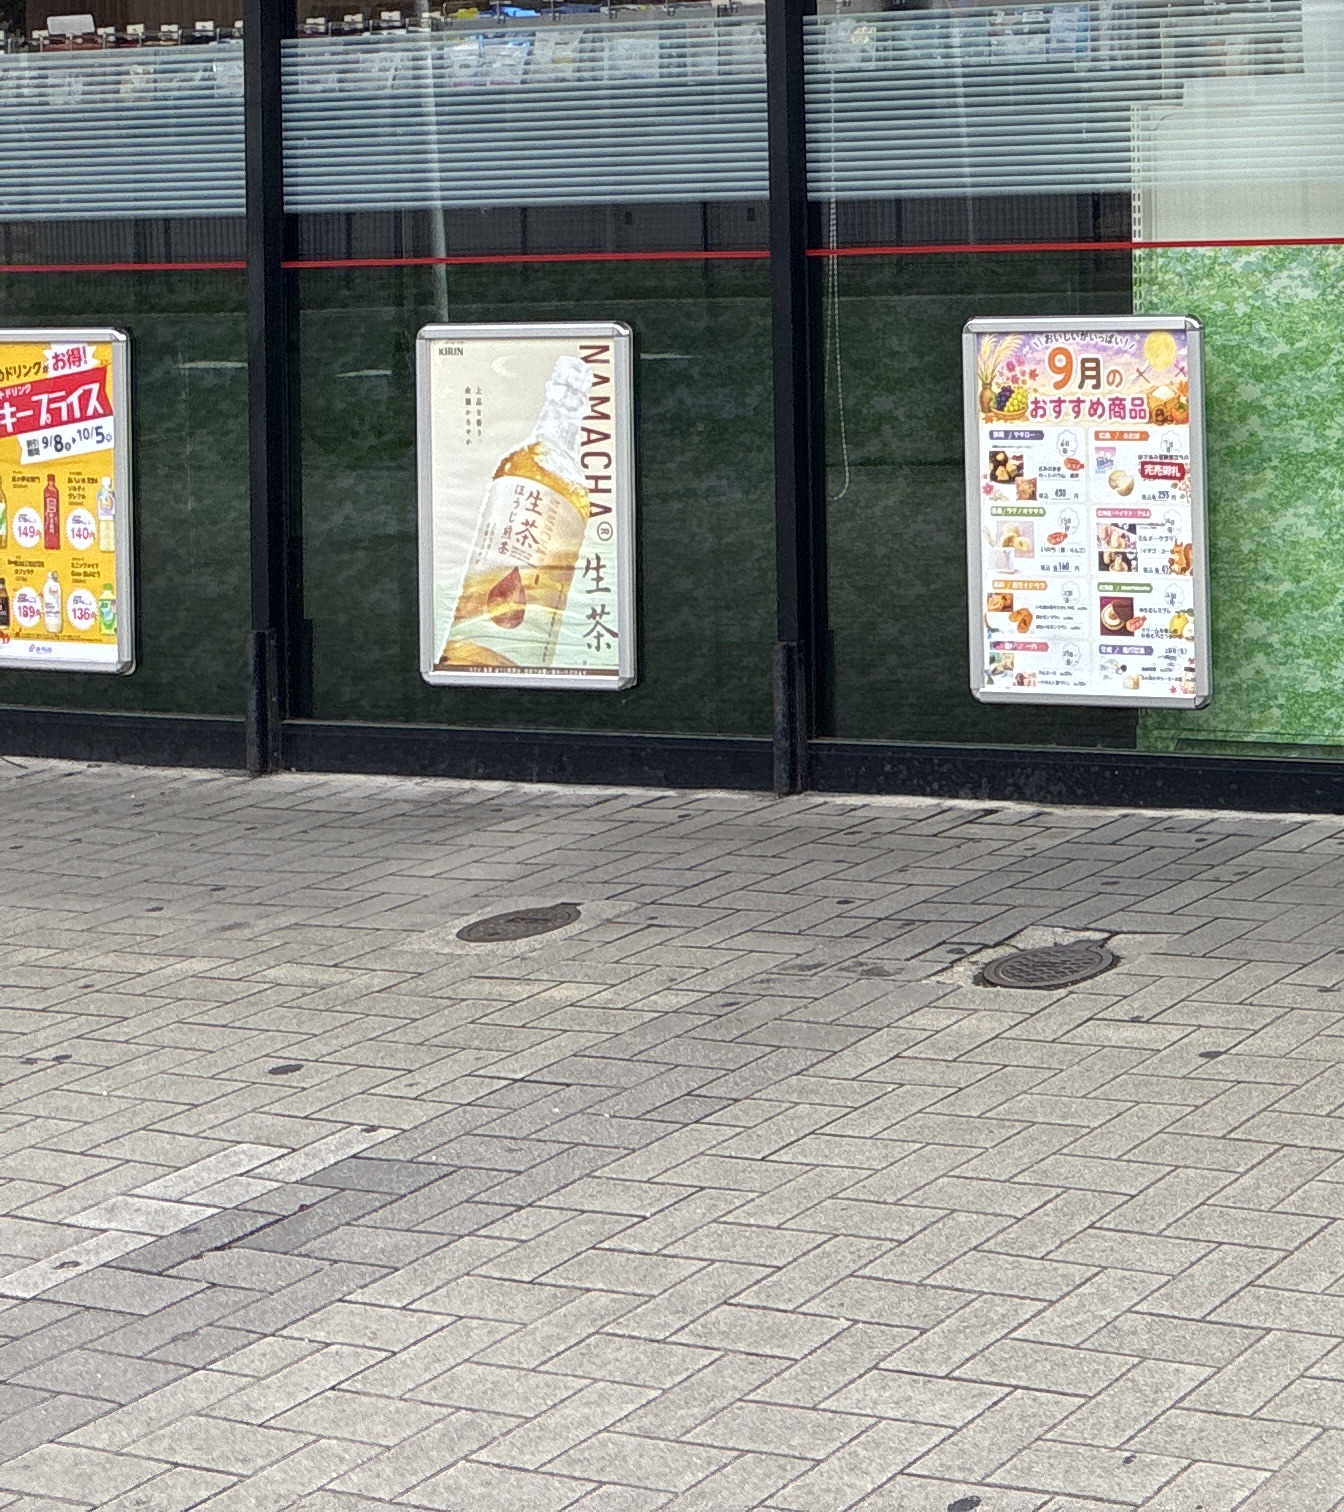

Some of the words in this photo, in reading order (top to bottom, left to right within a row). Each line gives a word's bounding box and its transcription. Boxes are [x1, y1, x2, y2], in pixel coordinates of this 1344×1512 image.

[51, 346, 89, 372] お得!
[438, 347, 464, 356] KIRIN
[1047, 346, 1123, 391] 9月の
[0, 381, 104, 434] キープライス
[1030, 396, 1147, 420] おすすめ商品
[515, 489, 543, 548] 生茶
[582, 553, 619, 653] 生茶
